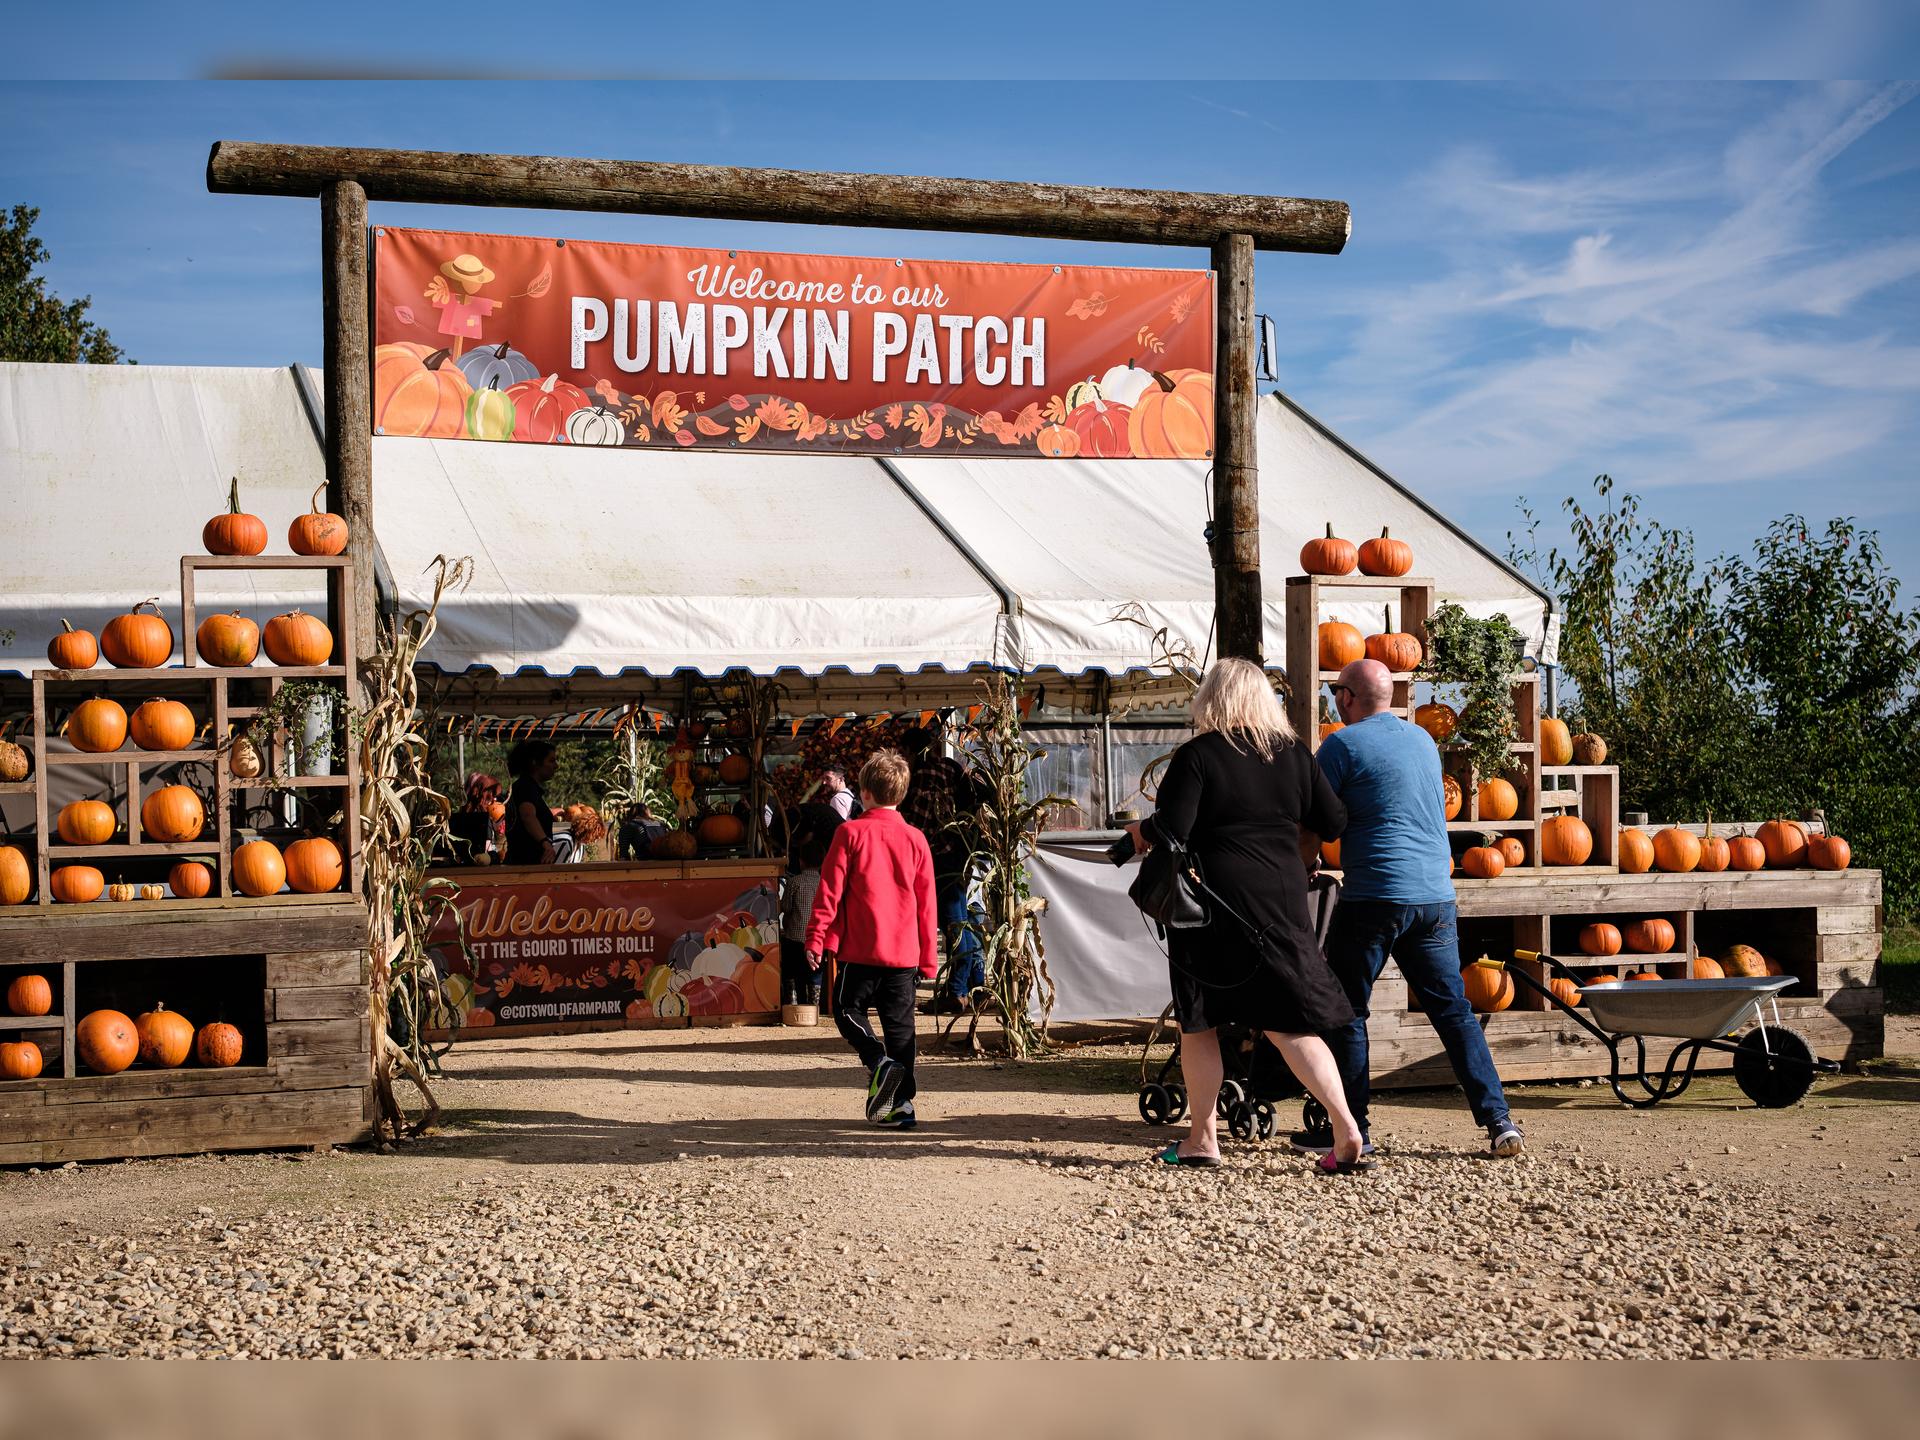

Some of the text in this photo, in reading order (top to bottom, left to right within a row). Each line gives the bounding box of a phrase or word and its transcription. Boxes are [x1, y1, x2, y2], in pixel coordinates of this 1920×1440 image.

[687, 264, 949, 308] Welcome to our
[570, 296, 1045, 387] PUMPKIN PATCH
[460, 895, 655, 938] Welcome
[491, 941, 518, 959] THE
[522, 938, 567, 958] GOURD
[571, 937, 612, 956] TIMES
[616, 936, 655, 953] ROLL!
[500, 1000, 621, 1020] @COTSWOLDFARMPARK
